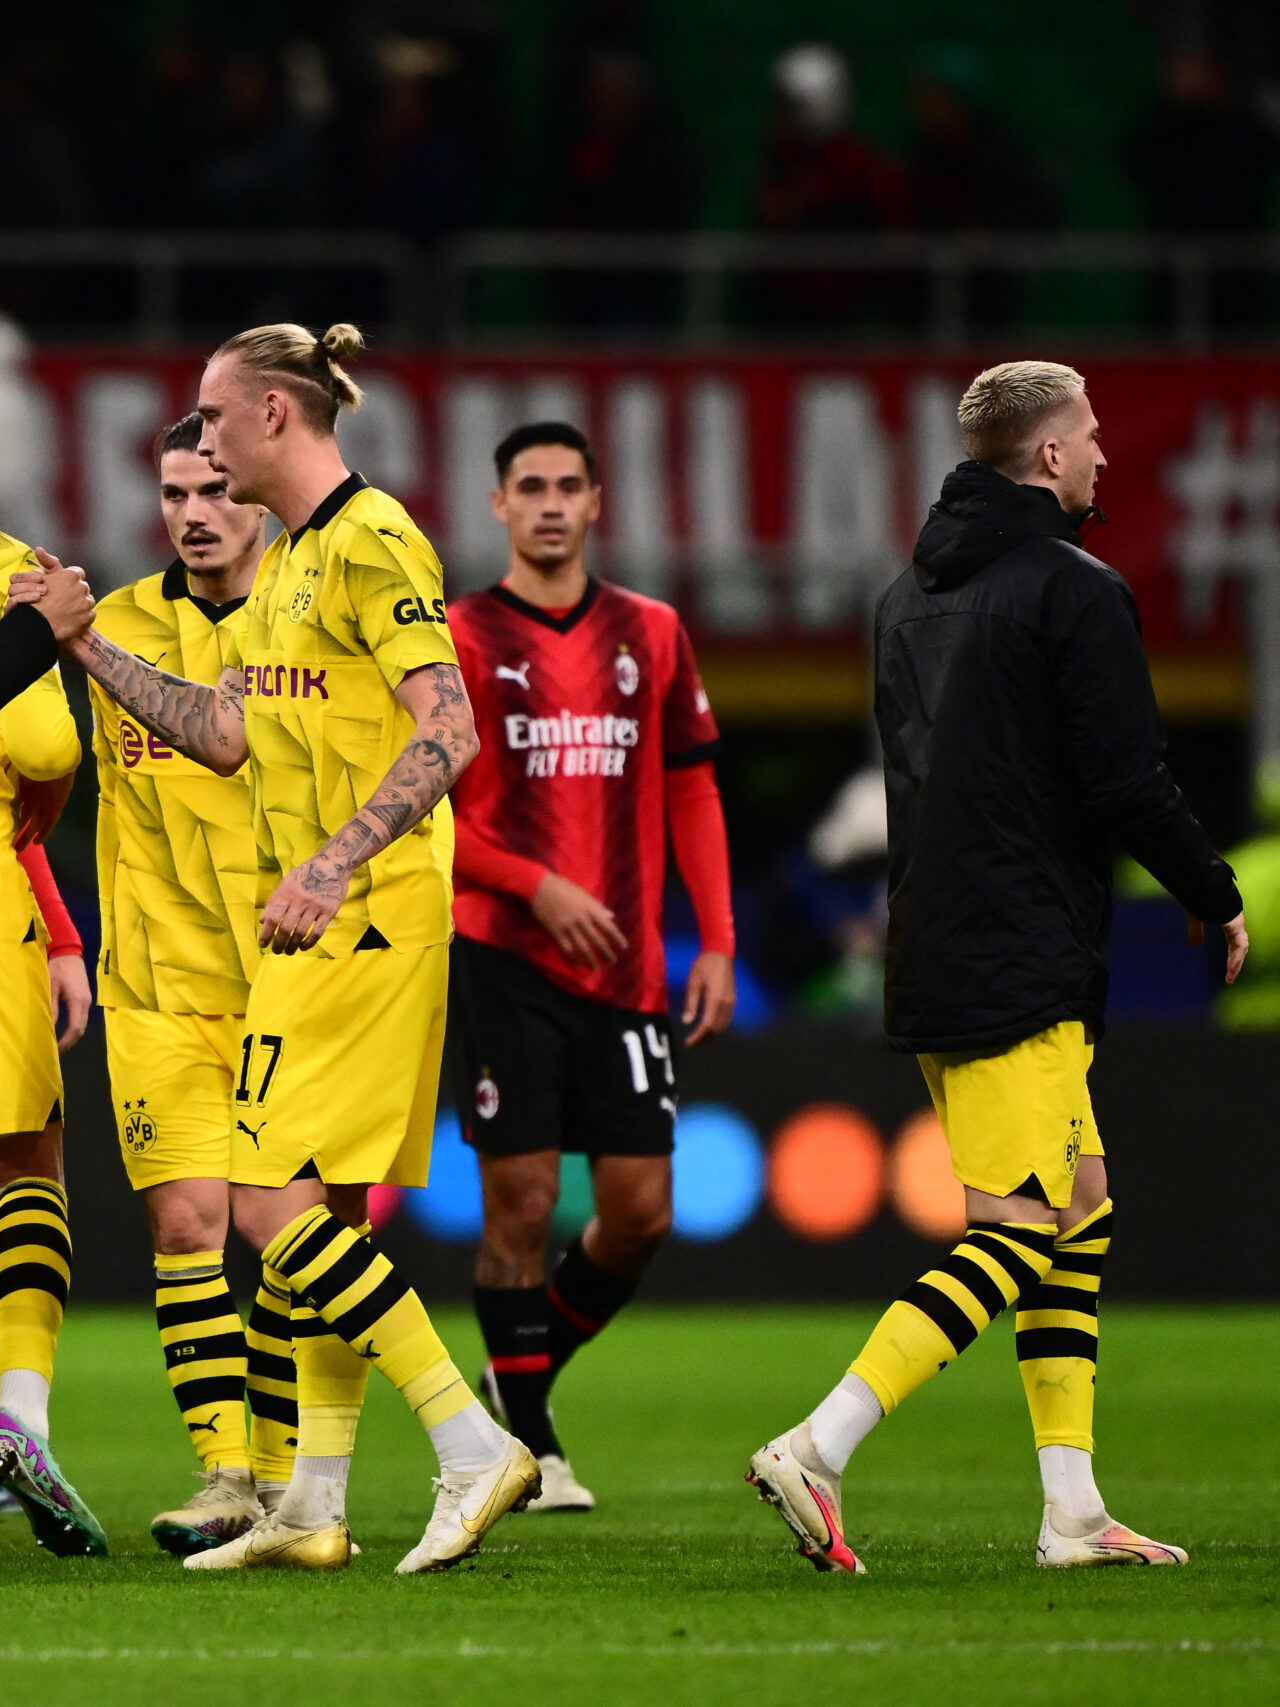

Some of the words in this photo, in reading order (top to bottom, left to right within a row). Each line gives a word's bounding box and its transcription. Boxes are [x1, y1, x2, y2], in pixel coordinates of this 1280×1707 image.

[504, 709, 640, 749] Emirates
[525, 749, 560, 778] FLY
[562, 748, 626, 777] BETTER
[235, 1033, 285, 1109] 17
[622, 1023, 675, 1093] 14
[124, 1115, 154, 1145] BVB
[133, 1140, 146, 1152] 09
[174, 1345, 196, 1357] 19
